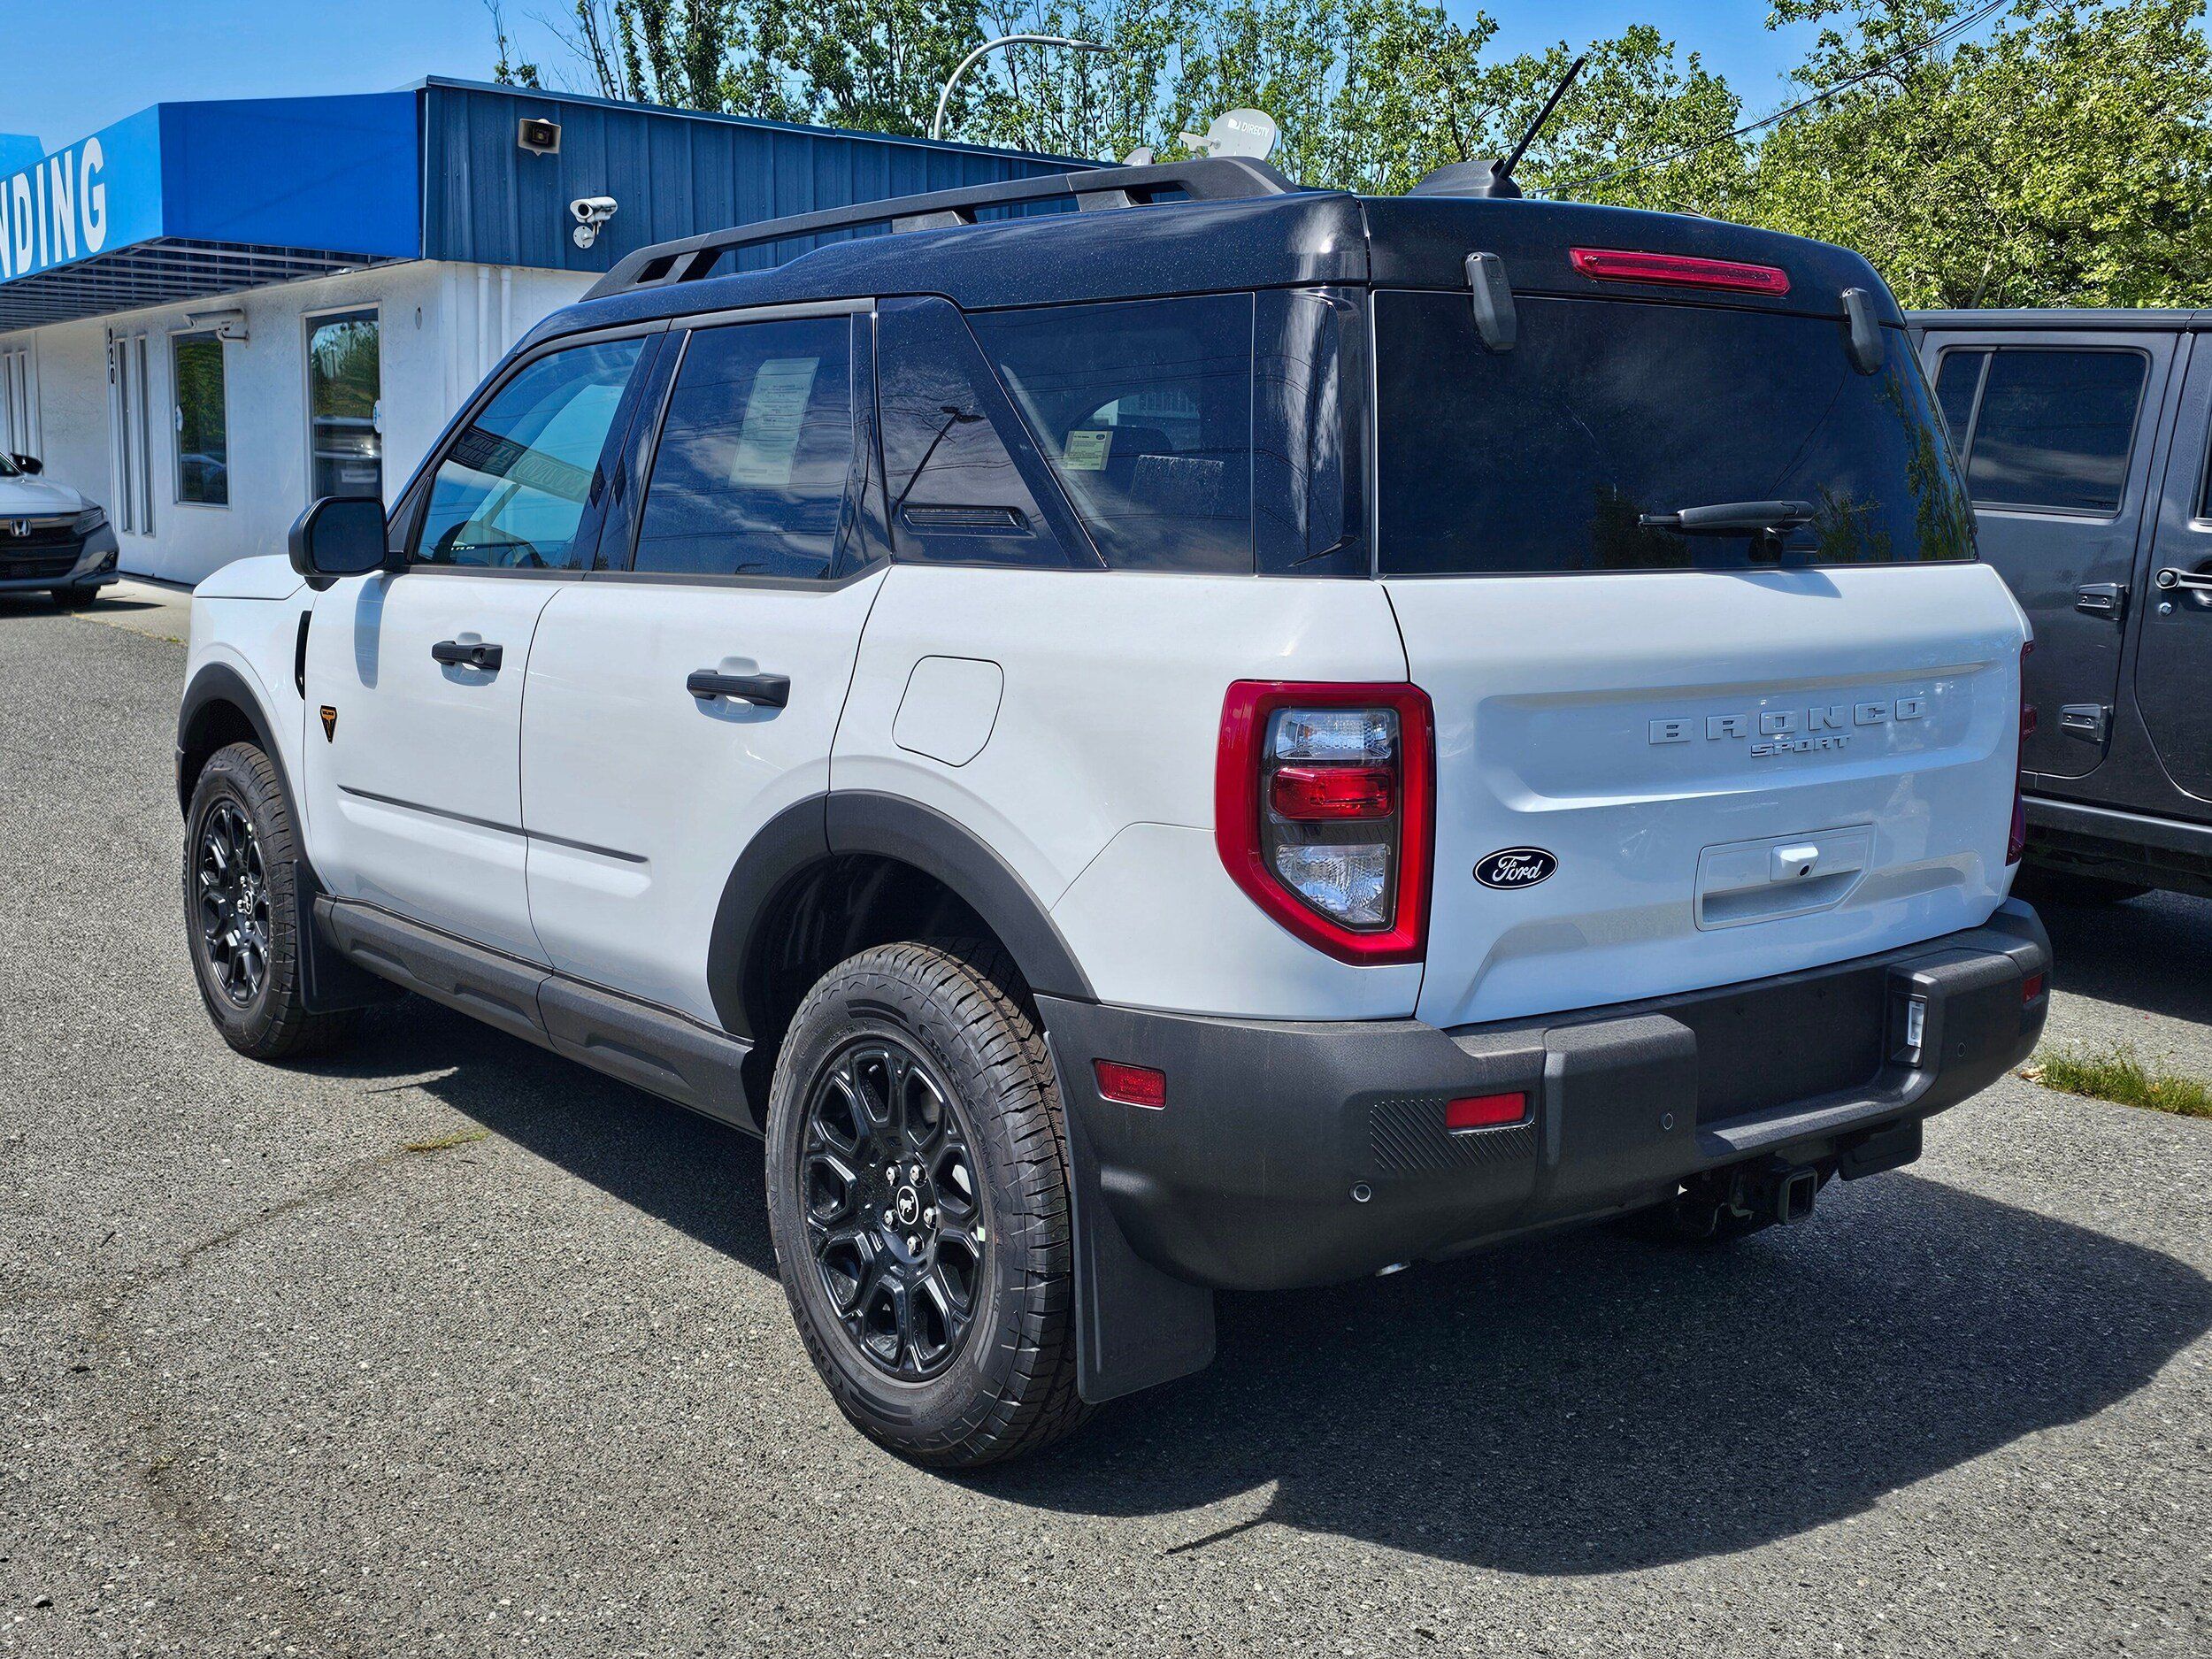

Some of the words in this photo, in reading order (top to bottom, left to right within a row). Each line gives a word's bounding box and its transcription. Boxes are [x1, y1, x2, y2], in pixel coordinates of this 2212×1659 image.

[1240, 121, 1270, 137] DIRECTV
[1648, 696, 1926, 745] BRONCO
[1750, 734, 1851, 758] SPORT
[1492, 855, 1544, 882] Ford
